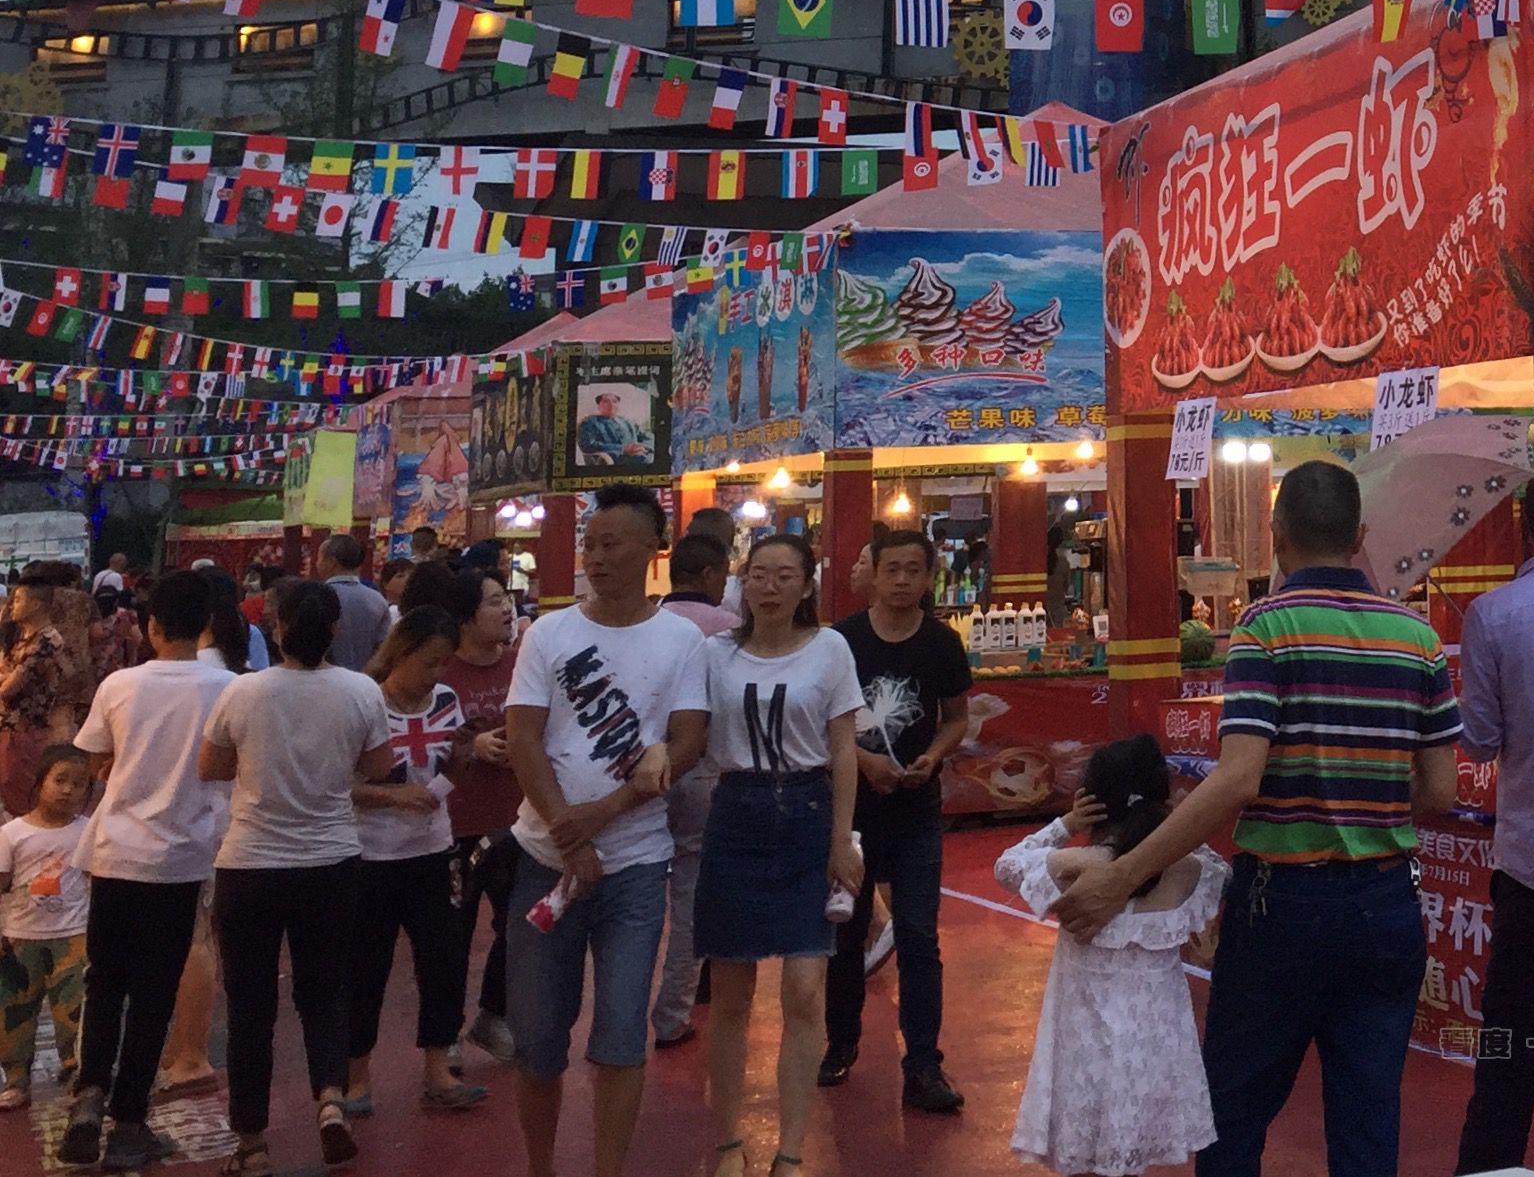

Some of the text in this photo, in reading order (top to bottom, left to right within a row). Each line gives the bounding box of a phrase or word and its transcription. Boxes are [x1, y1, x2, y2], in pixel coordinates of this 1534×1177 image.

[1156, 47, 1438, 285] 疯狂一虾
[1387, 183, 1507, 324] 又到了吃虾的季节
[897, 343, 1047, 379] 多种口味
[1379, 375, 1435, 409] 小龙虾
[945, 407, 1037, 430] 芒果味
[1176, 403, 1213, 434] 小龙虾
[1170, 450, 1206, 474] 78元/斤
